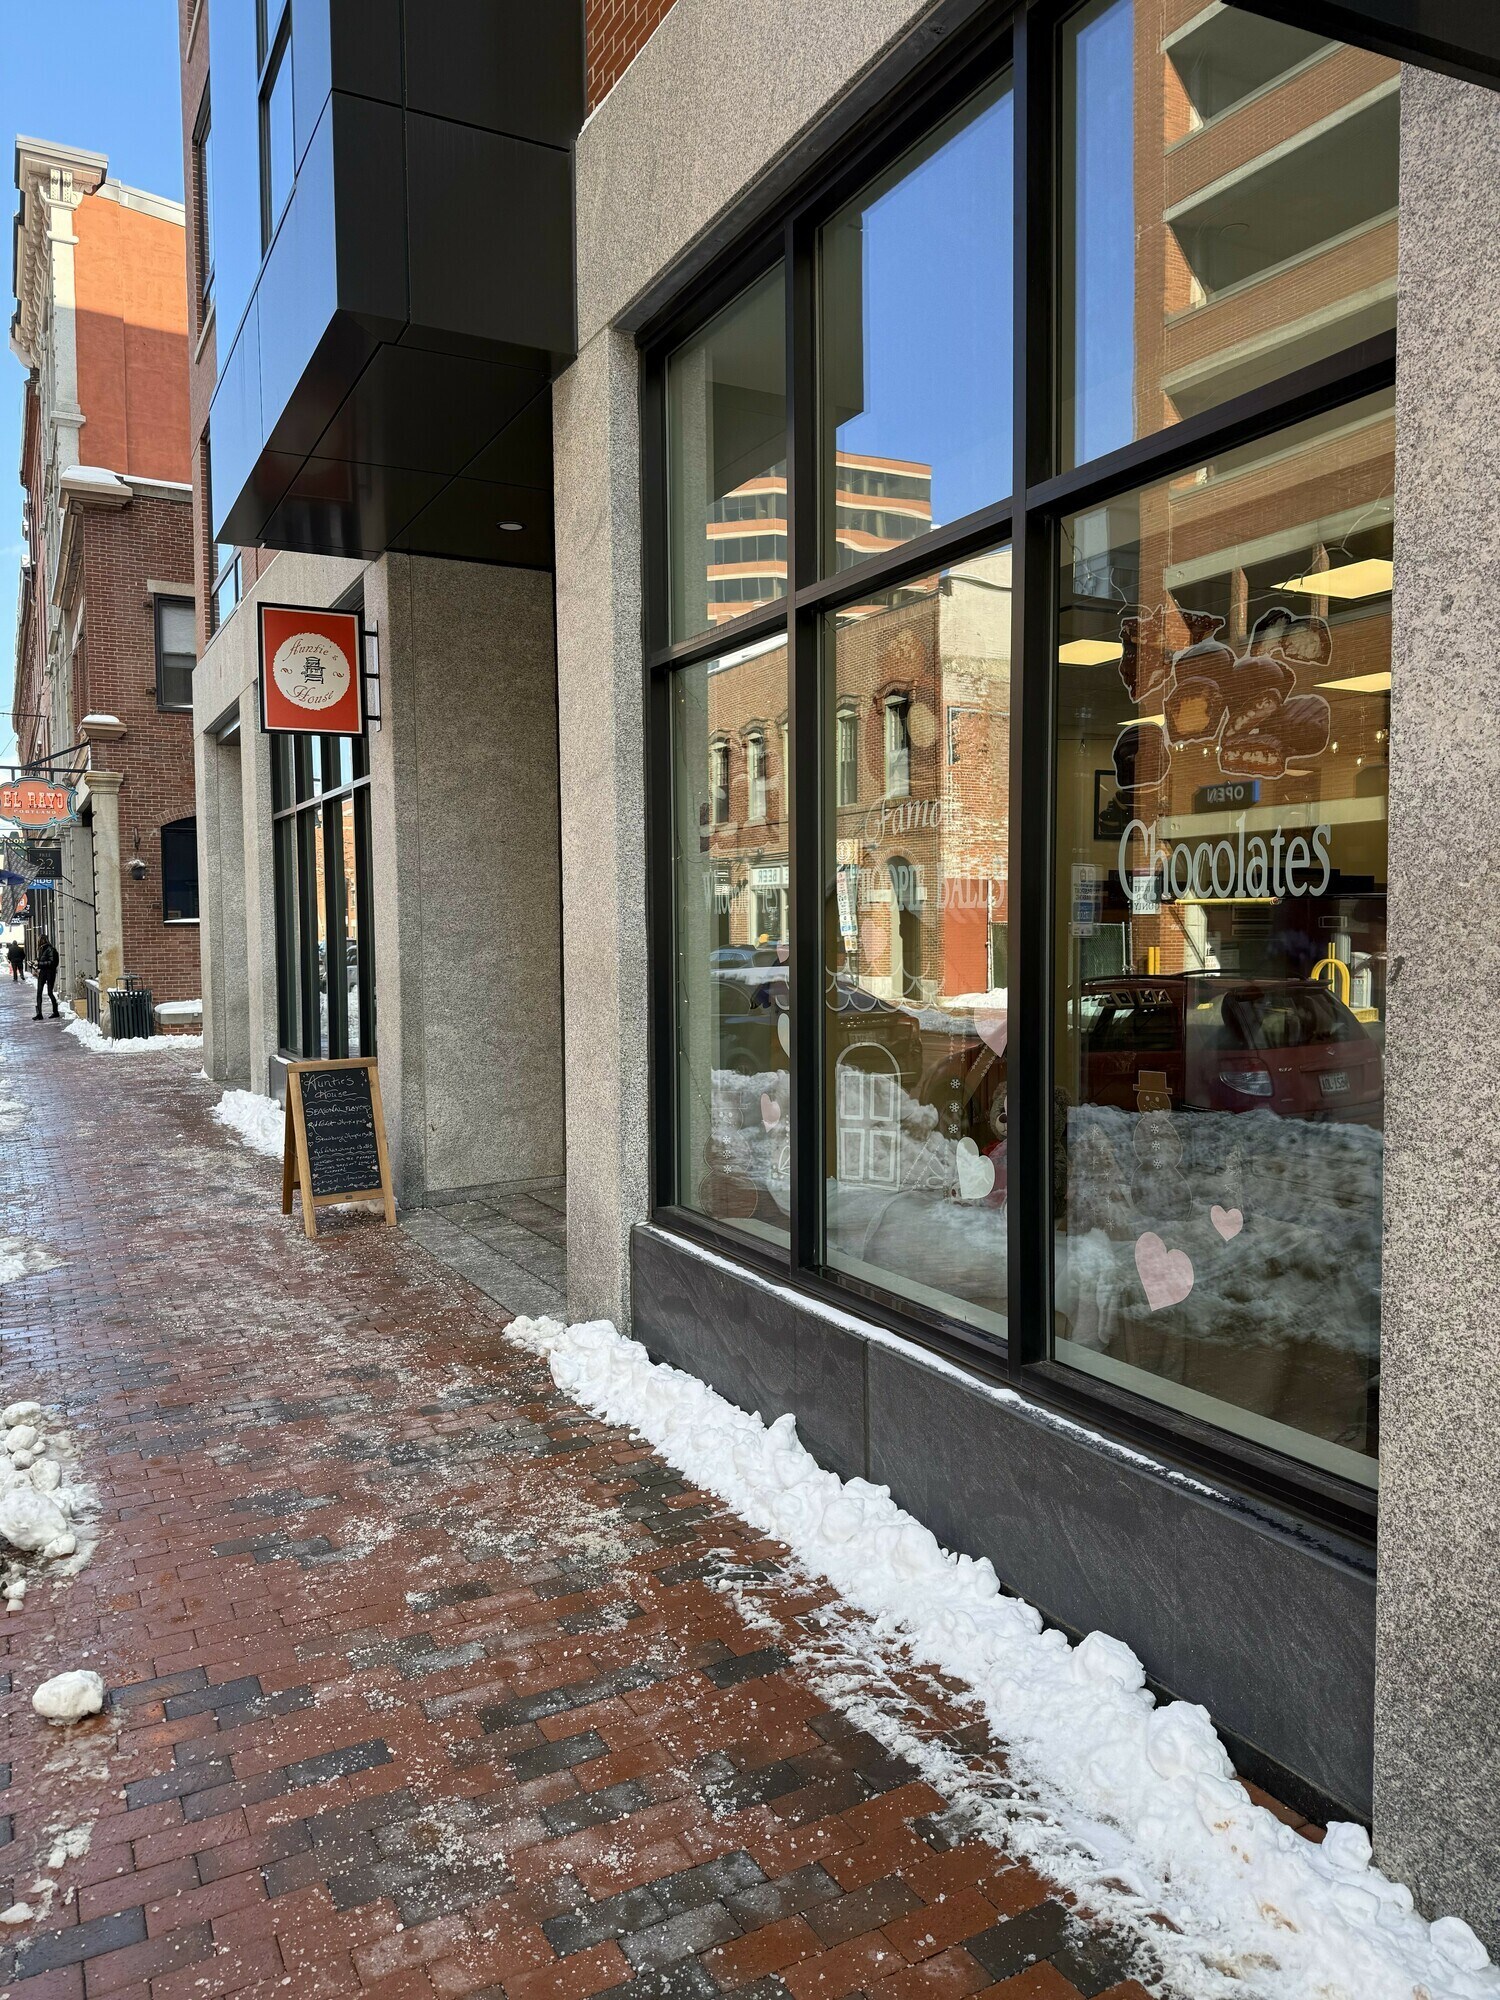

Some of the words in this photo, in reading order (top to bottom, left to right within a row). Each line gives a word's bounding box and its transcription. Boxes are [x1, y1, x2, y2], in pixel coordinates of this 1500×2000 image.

[282, 639, 338, 661] Auntie's
[286, 685, 334, 704] House
[3, 791, 21, 808] EL
[27, 791, 65, 809] RAYO
[304, 1074, 355, 1092] Auntie's
[314, 1089, 357, 1099] House
